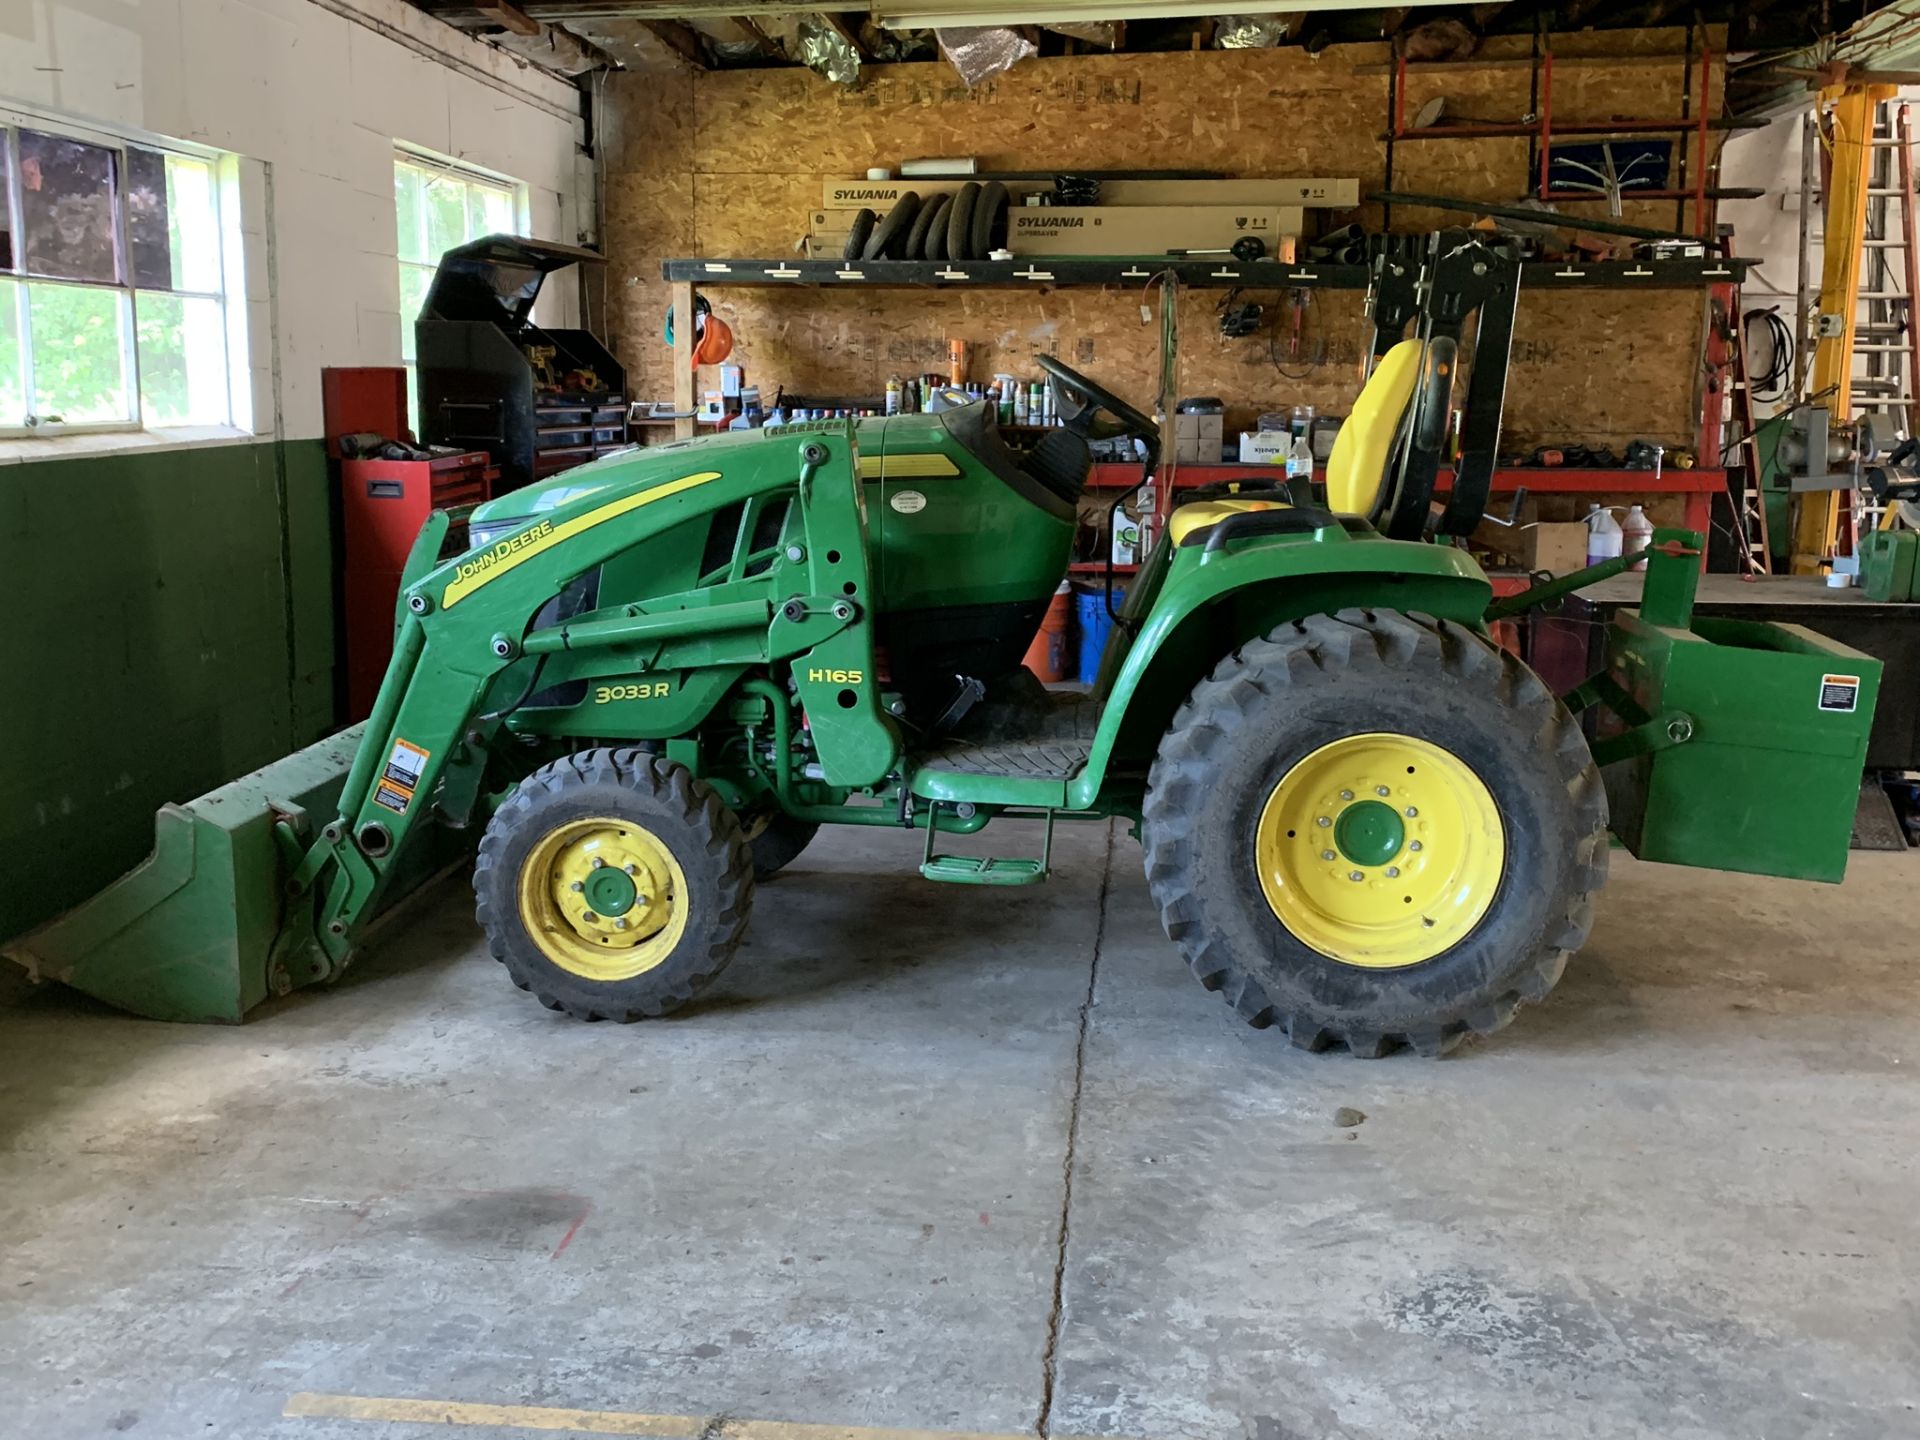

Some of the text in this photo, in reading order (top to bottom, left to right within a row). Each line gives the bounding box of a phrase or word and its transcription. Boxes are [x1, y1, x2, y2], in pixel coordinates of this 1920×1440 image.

[834, 189, 898, 200] SYLVANIA
[1017, 216, 1084, 227] SYLVANIA
[453, 519, 554, 585] JOHN DEERE
[809, 668, 863, 684] H165
[595, 683, 651, 704] 3033
